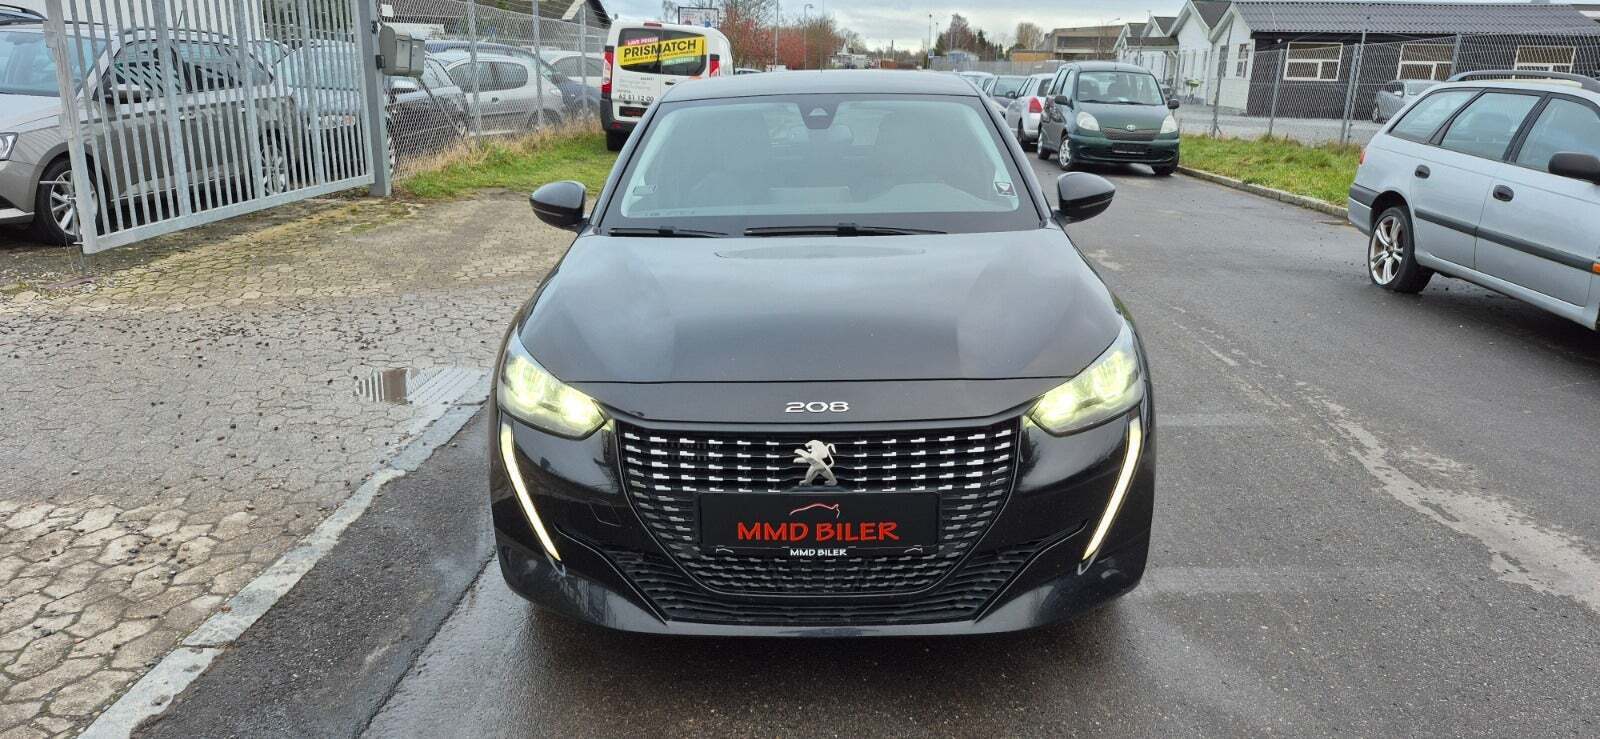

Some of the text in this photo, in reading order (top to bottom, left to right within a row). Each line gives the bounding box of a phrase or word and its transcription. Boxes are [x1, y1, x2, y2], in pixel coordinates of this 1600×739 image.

[623, 39, 697, 57] PRISMATCH
[785, 401, 850, 413] 208
[737, 522, 900, 541] MMD BILER
[790, 548, 847, 556] MMD BILER
